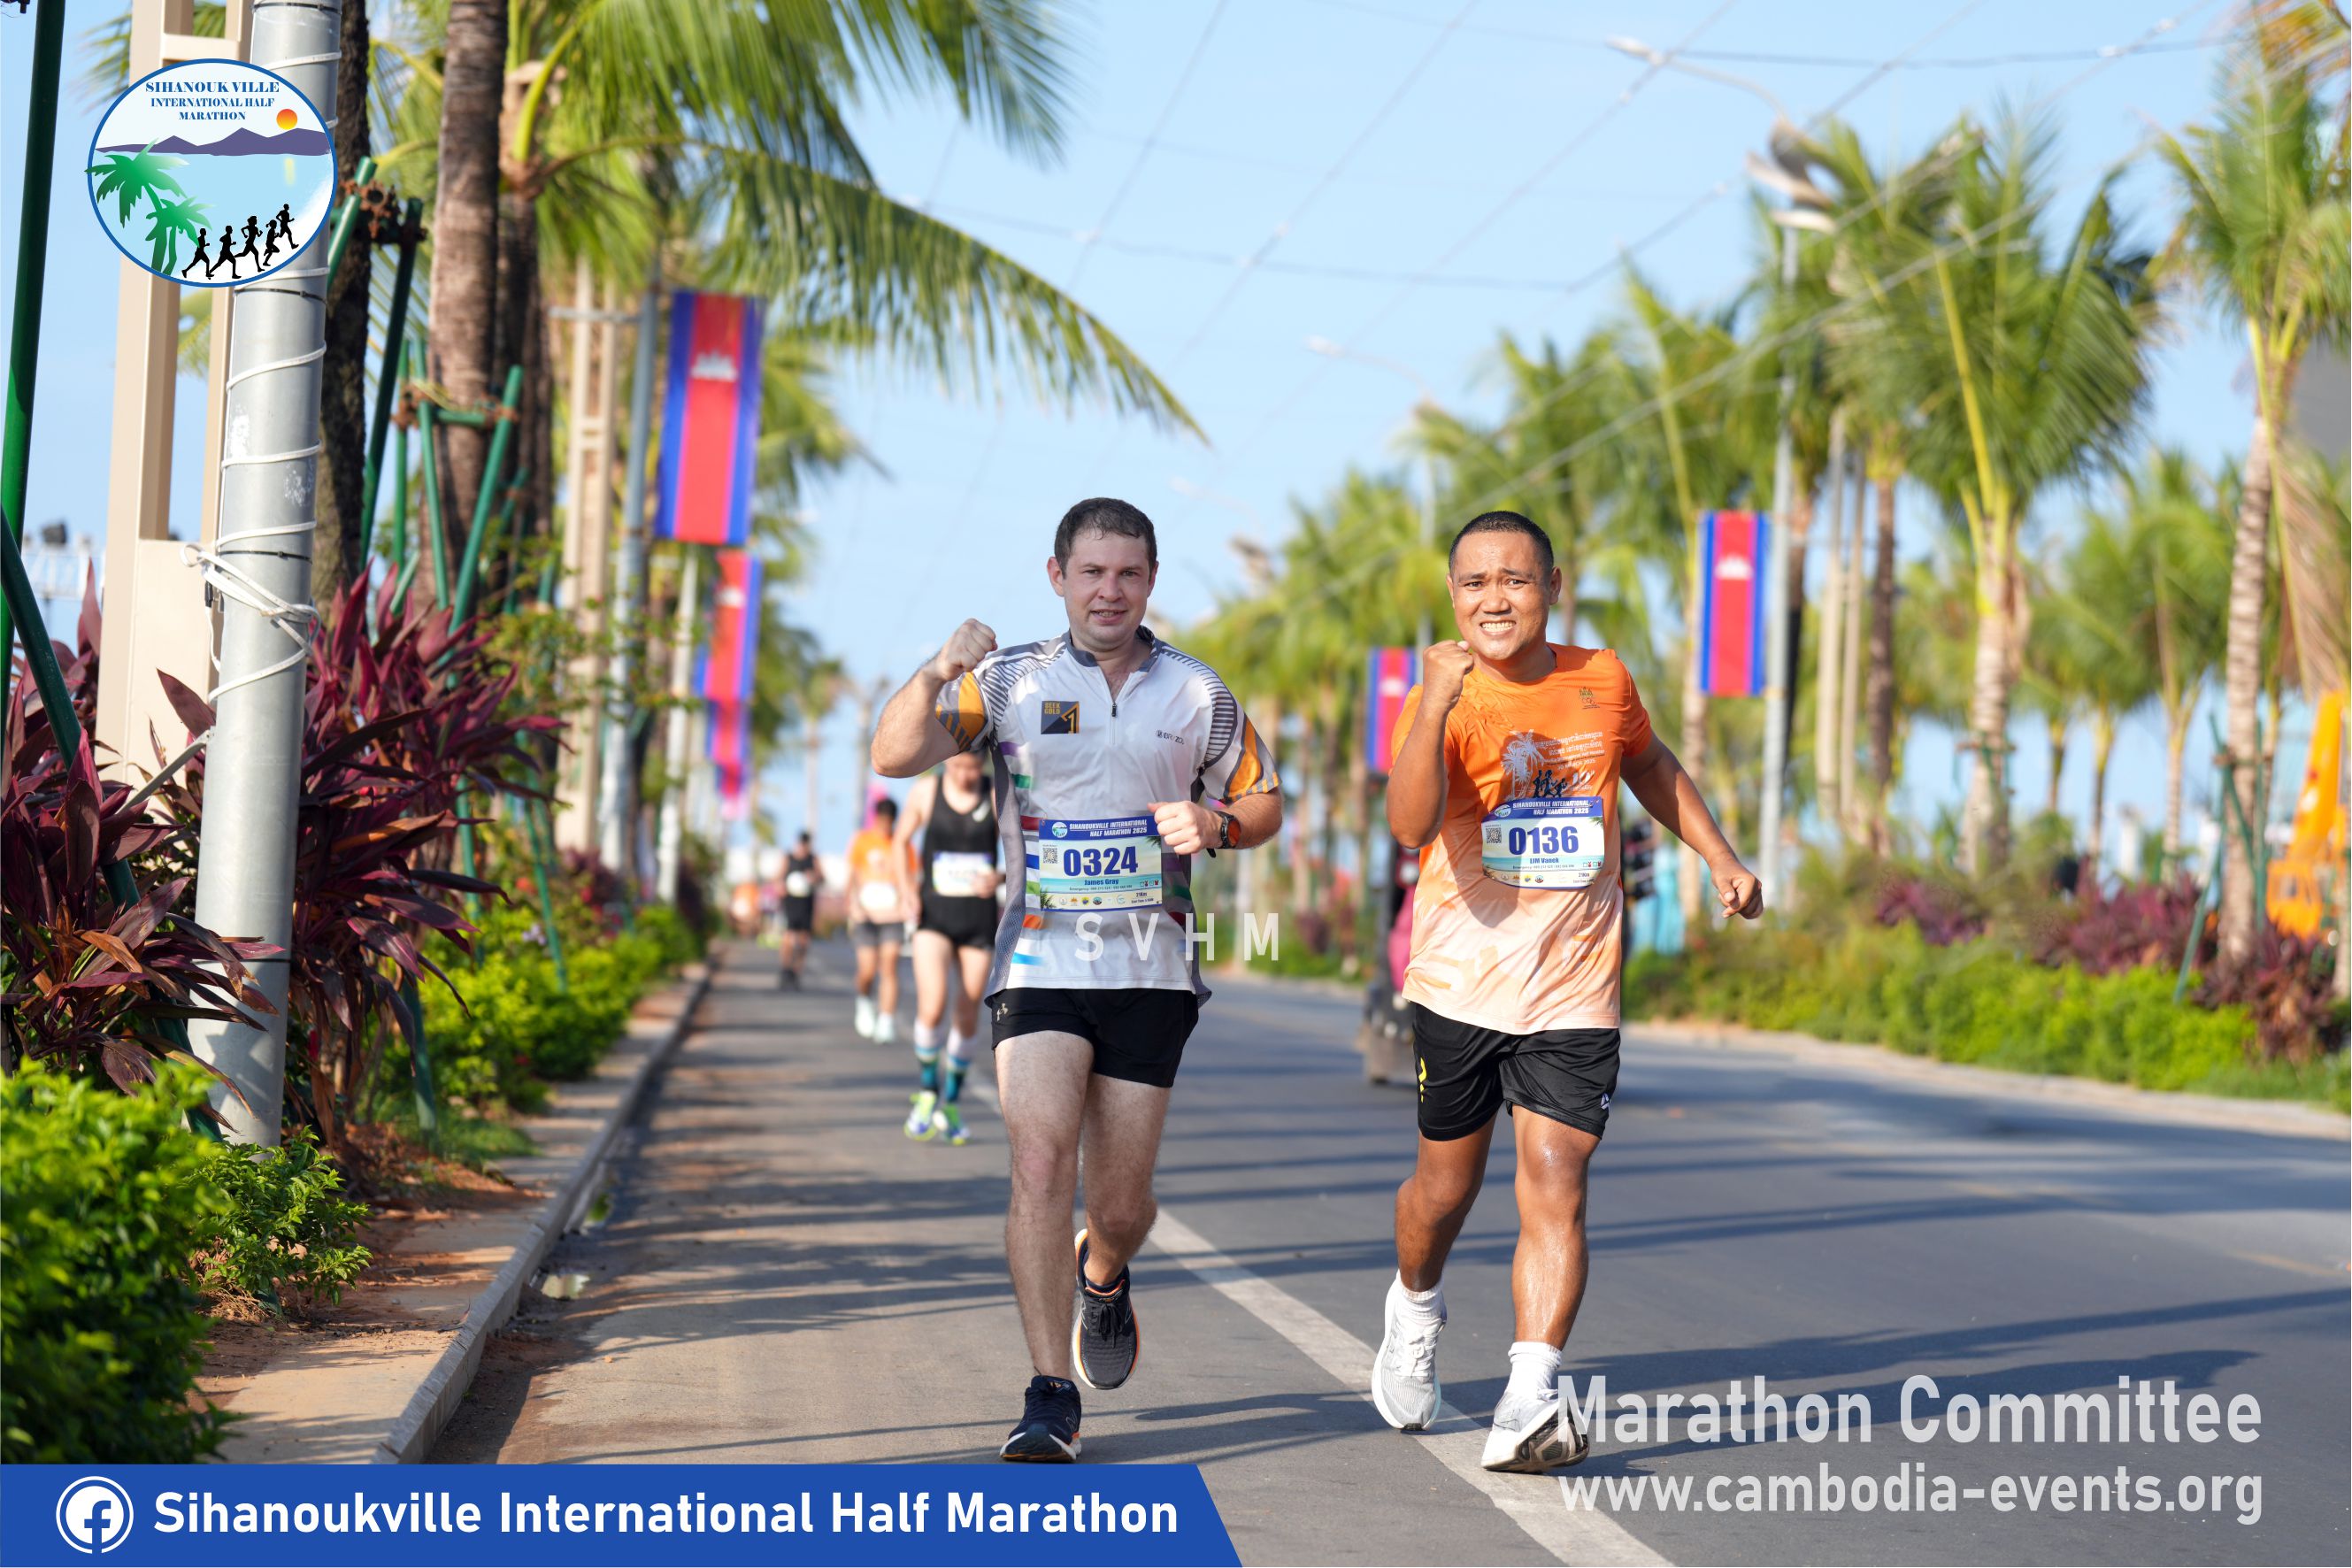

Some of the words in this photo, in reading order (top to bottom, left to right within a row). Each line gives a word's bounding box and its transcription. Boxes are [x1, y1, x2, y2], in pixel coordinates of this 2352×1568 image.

[1110, 819, 1148, 827] INTERNATIONAL
[1509, 826, 1579, 856] 0136
[1063, 846, 1139, 876] 0324
